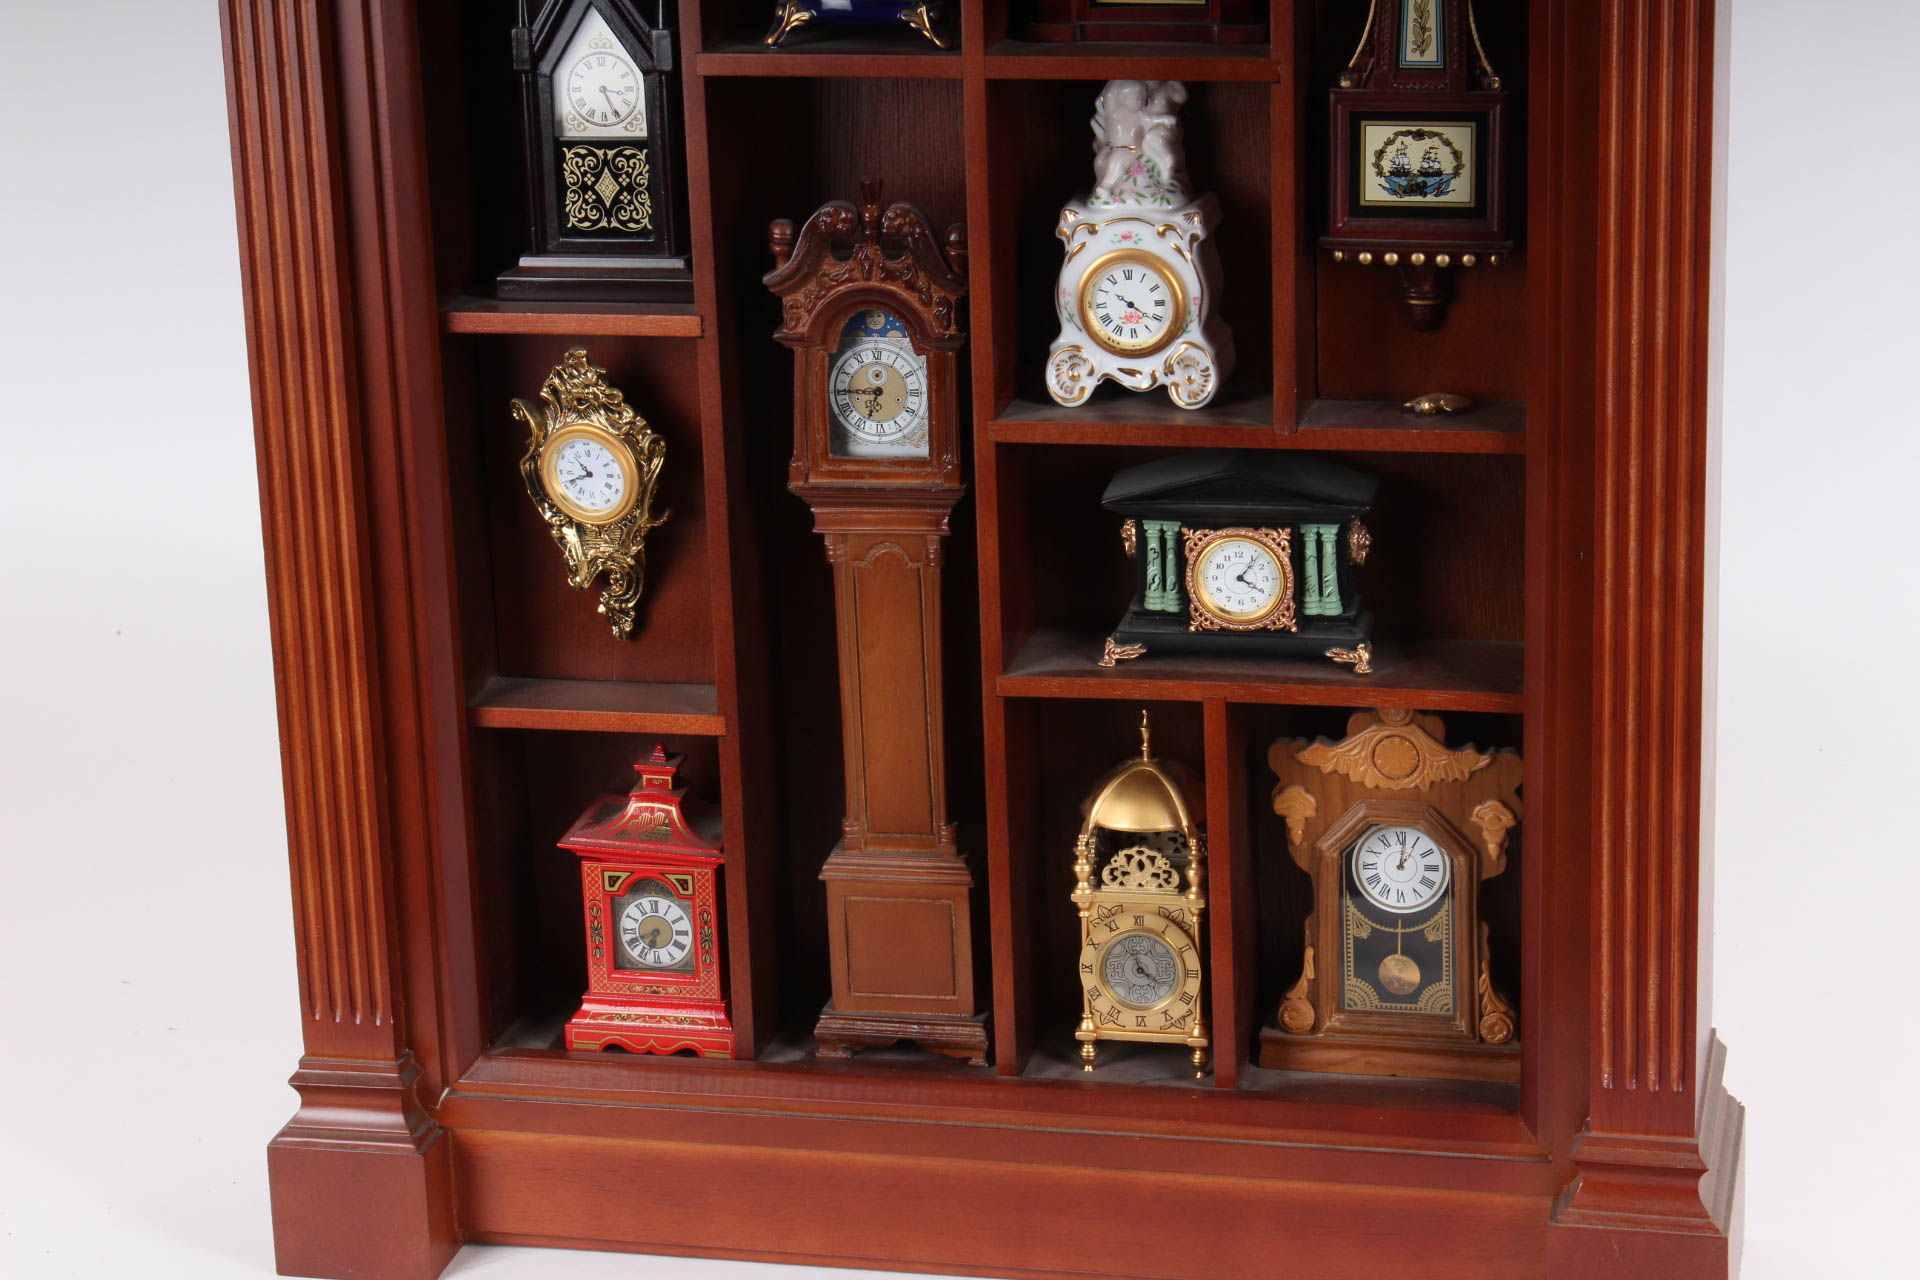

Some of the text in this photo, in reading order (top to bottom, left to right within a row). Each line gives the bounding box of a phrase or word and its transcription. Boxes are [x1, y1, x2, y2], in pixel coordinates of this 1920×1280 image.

[1123, 270, 1133, 280] XII
[872, 351, 882, 360] XII
[1377, 835, 1391, 850] XI
[1395, 831, 1406, 845] XII
[1366, 847, 1381, 857] X
[1420, 848, 1434, 858] II
[1363, 861, 1378, 870] IX
[1424, 864, 1439, 872] III
[1366, 873, 1381, 889] VIII
[1420, 876, 1436, 890] IIII
[1378, 883, 1391, 900] VII
[1397, 889, 1406, 903] VI
[1413, 888, 1423, 900] V
[648, 900, 659, 913] XII
[1105, 920, 1120, 932] XI
[1133, 916, 1144, 926] XII
[1087, 938, 1101, 951] X
[1179, 944, 1192, 953] II
[1082, 963, 1092, 973] IX
[1187, 969, 1198, 979] III
[1136, 1016, 1147, 1027] VI
